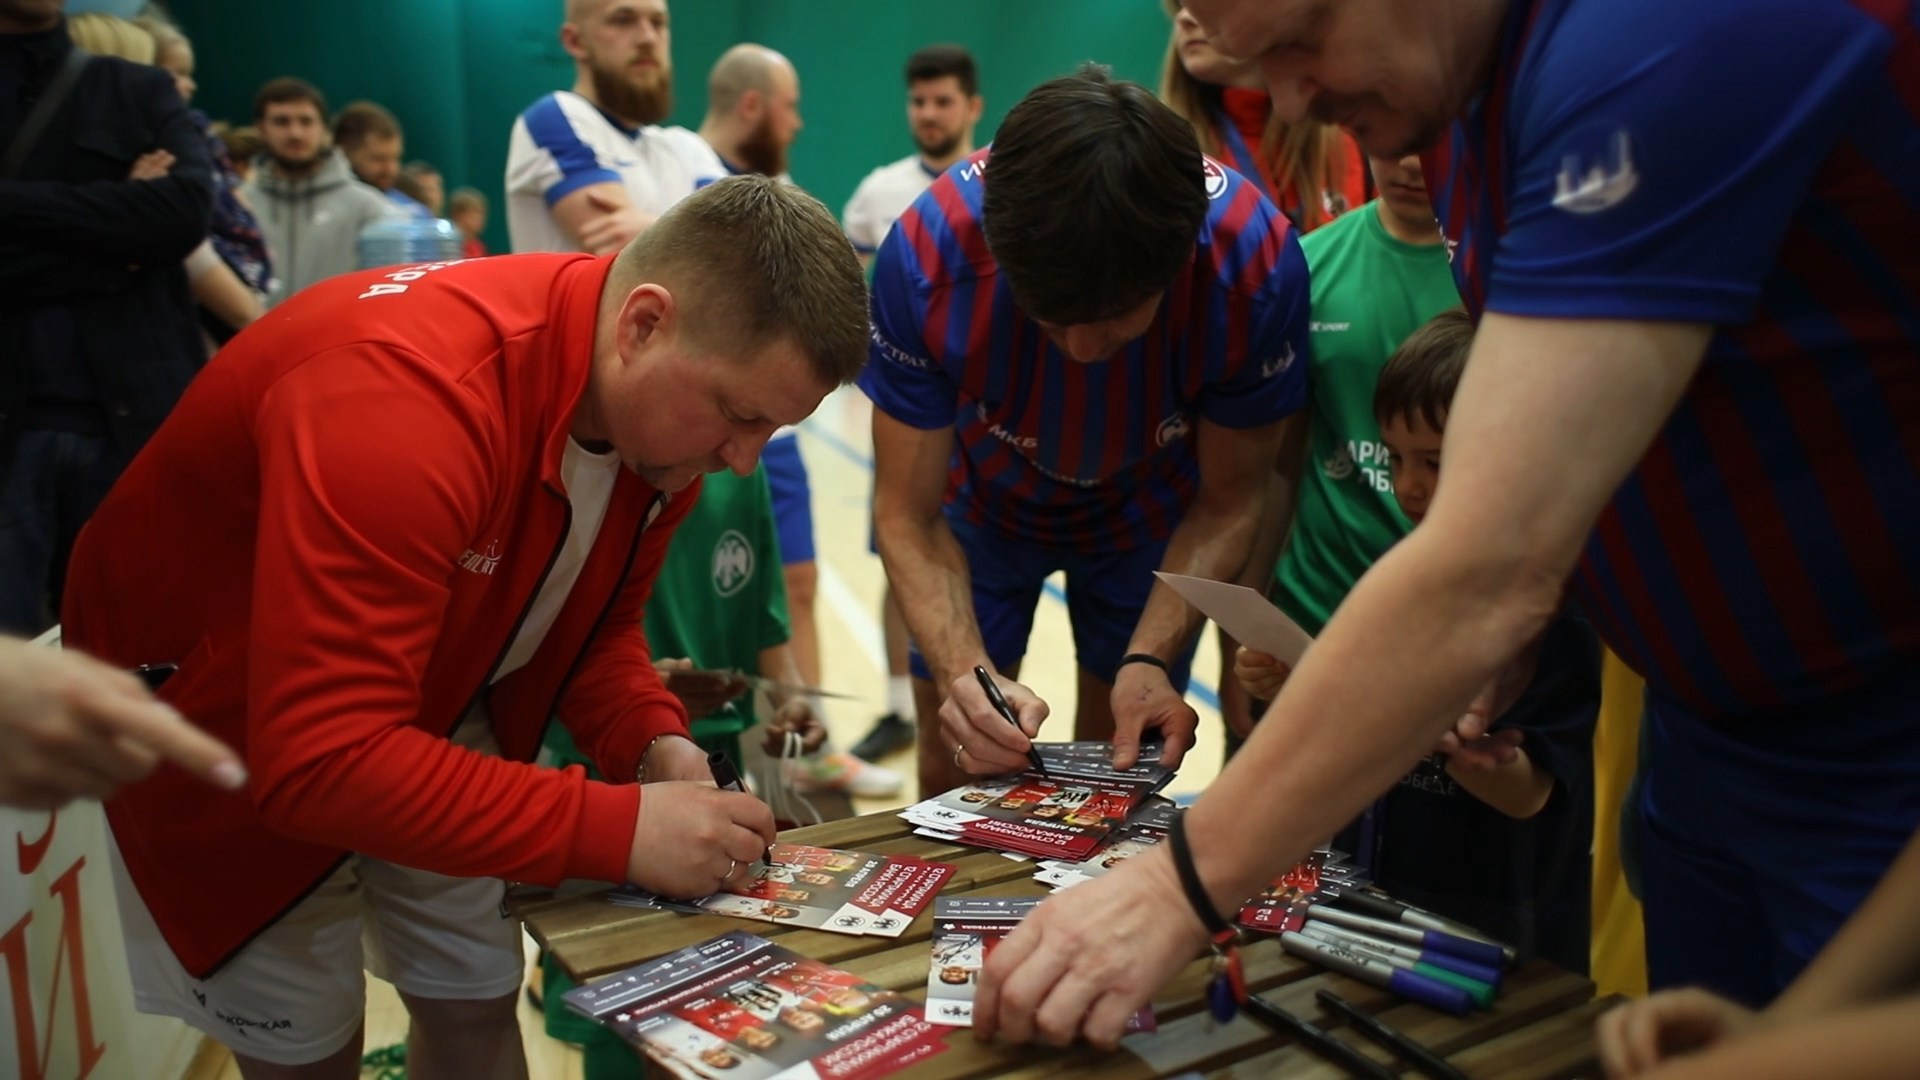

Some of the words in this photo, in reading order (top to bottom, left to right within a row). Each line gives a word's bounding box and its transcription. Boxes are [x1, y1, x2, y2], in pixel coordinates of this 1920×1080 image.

[988, 820, 1036, 834] РОССИИ
[1024, 818, 1069, 831] АПРЕЛЯ
[975, 822, 1055, 844] СПАРТАКИАДА
[1035, 829, 1075, 842] БАНКА
